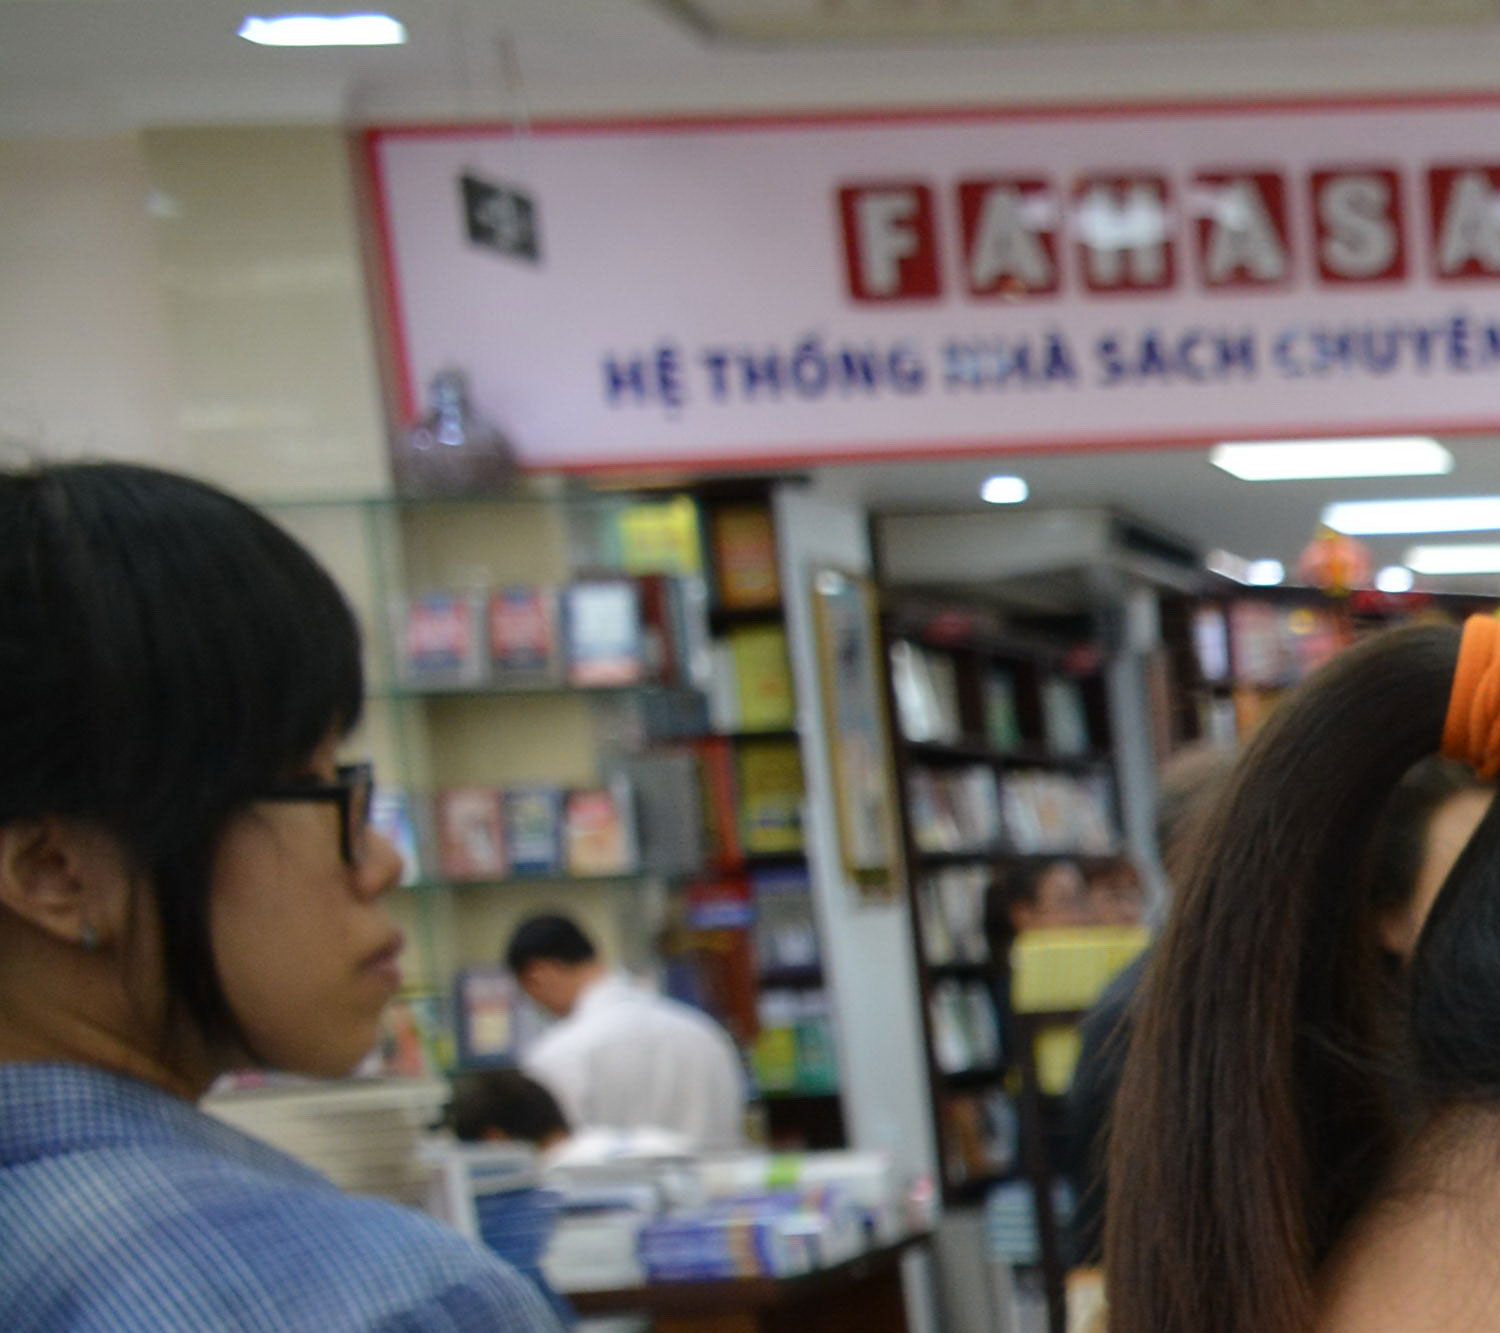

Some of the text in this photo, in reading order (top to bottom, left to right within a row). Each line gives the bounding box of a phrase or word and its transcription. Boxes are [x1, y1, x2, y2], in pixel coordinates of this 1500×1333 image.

[602, 336, 686, 418] HỆ
[701, 328, 928, 403] THỐNG
[1097, 320, 1259, 386] SÁCH
